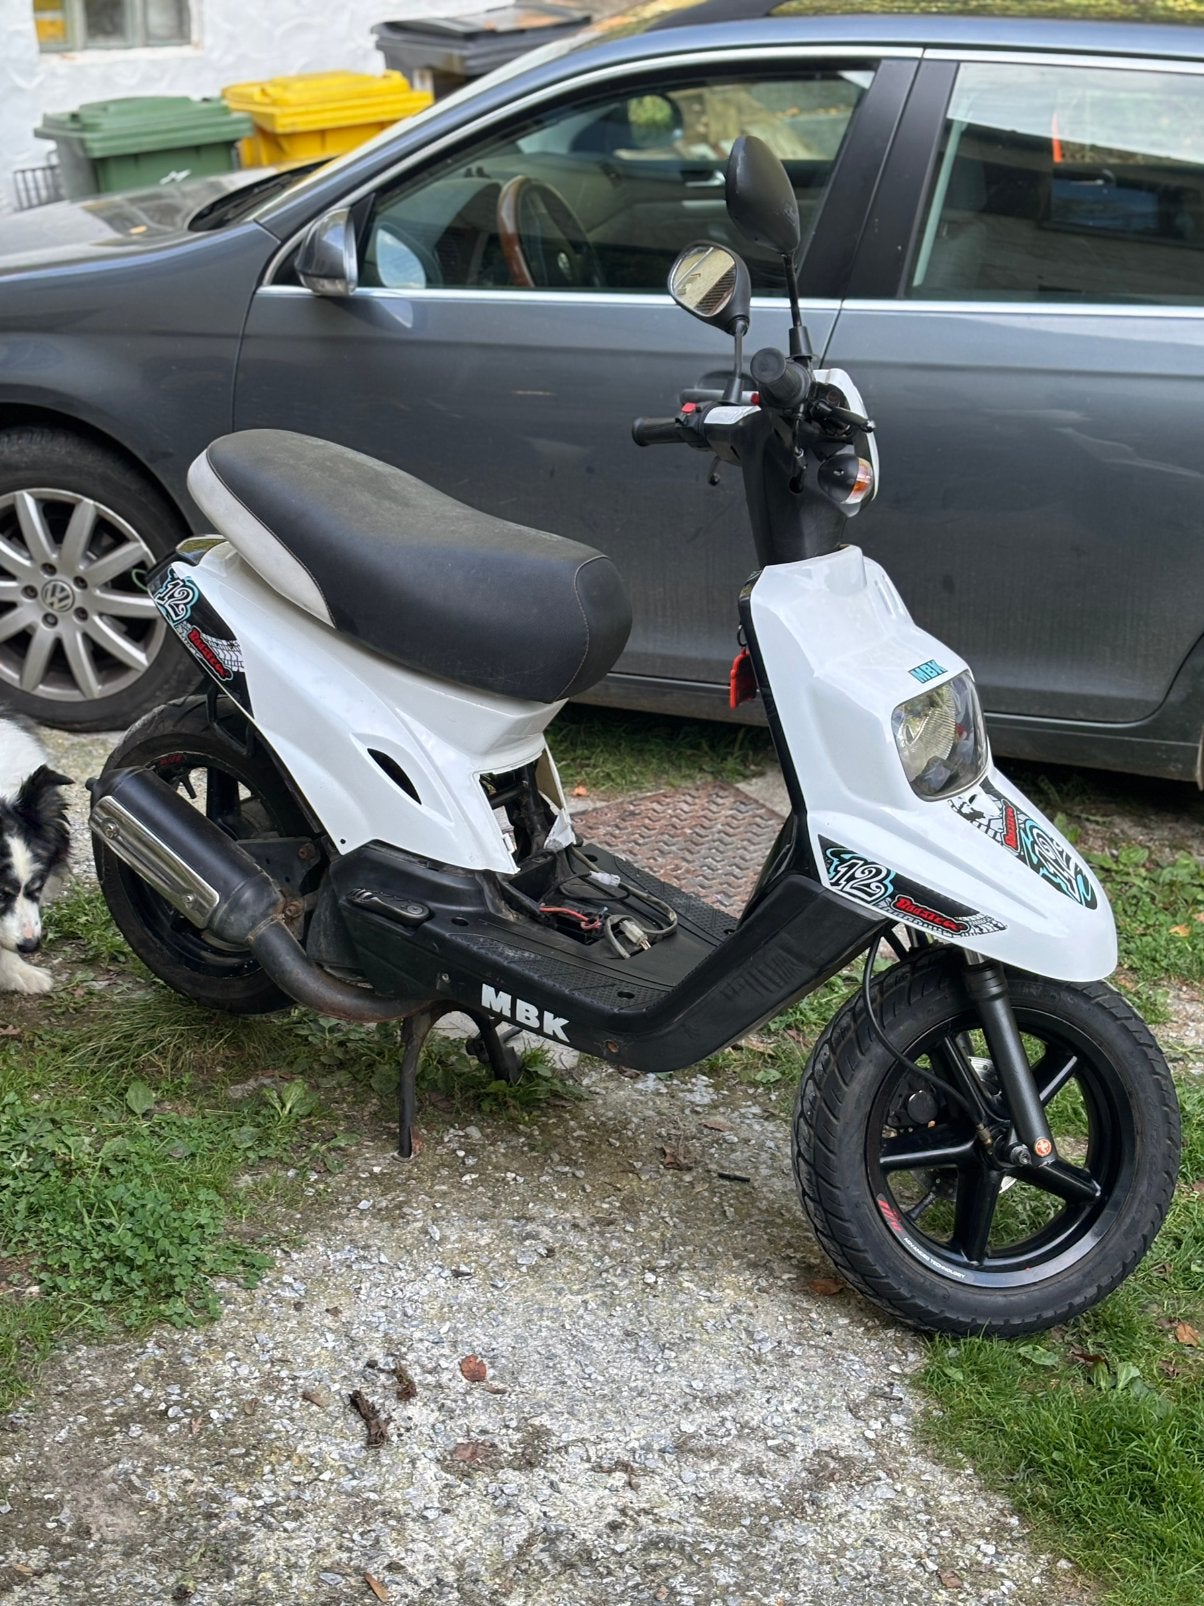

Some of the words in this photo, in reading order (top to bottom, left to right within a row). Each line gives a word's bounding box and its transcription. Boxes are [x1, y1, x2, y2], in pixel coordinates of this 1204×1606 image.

[153, 578, 195, 621] 12
[908, 659, 948, 684] MBK
[829, 858, 887, 902] 12
[481, 983, 570, 1042] MBK
